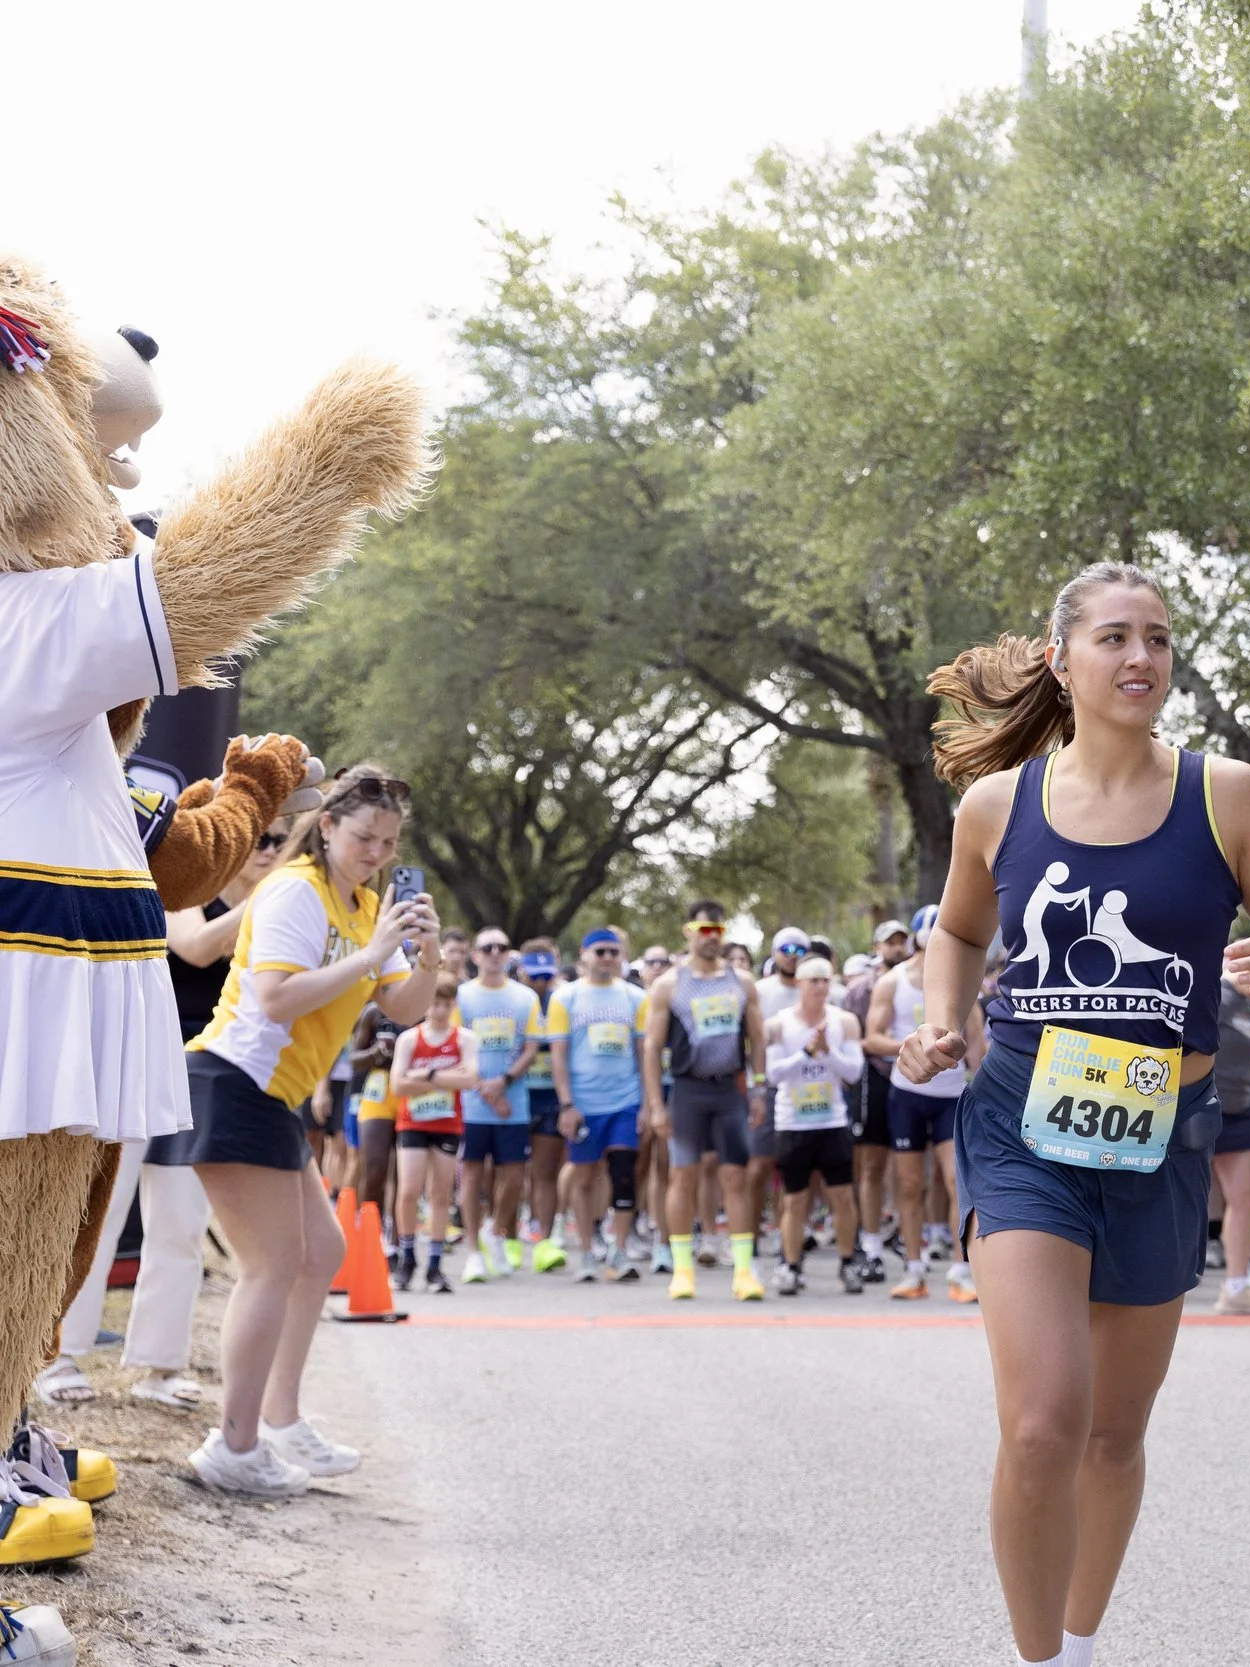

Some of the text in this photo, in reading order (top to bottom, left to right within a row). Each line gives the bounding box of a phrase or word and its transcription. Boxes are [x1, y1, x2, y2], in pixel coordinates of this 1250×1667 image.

[1012, 997, 1187, 1024] RACERS FOR PACERS
[1056, 1031, 1091, 1051] RUN
[1050, 1059, 1108, 1084] RUN 5K
[1053, 1046, 1122, 1072] CHARLIE
[1046, 1095, 1154, 1145] 4304
[1042, 1143, 1090, 1161] ONE BEER
[1121, 1156, 1141, 1166] ONE
